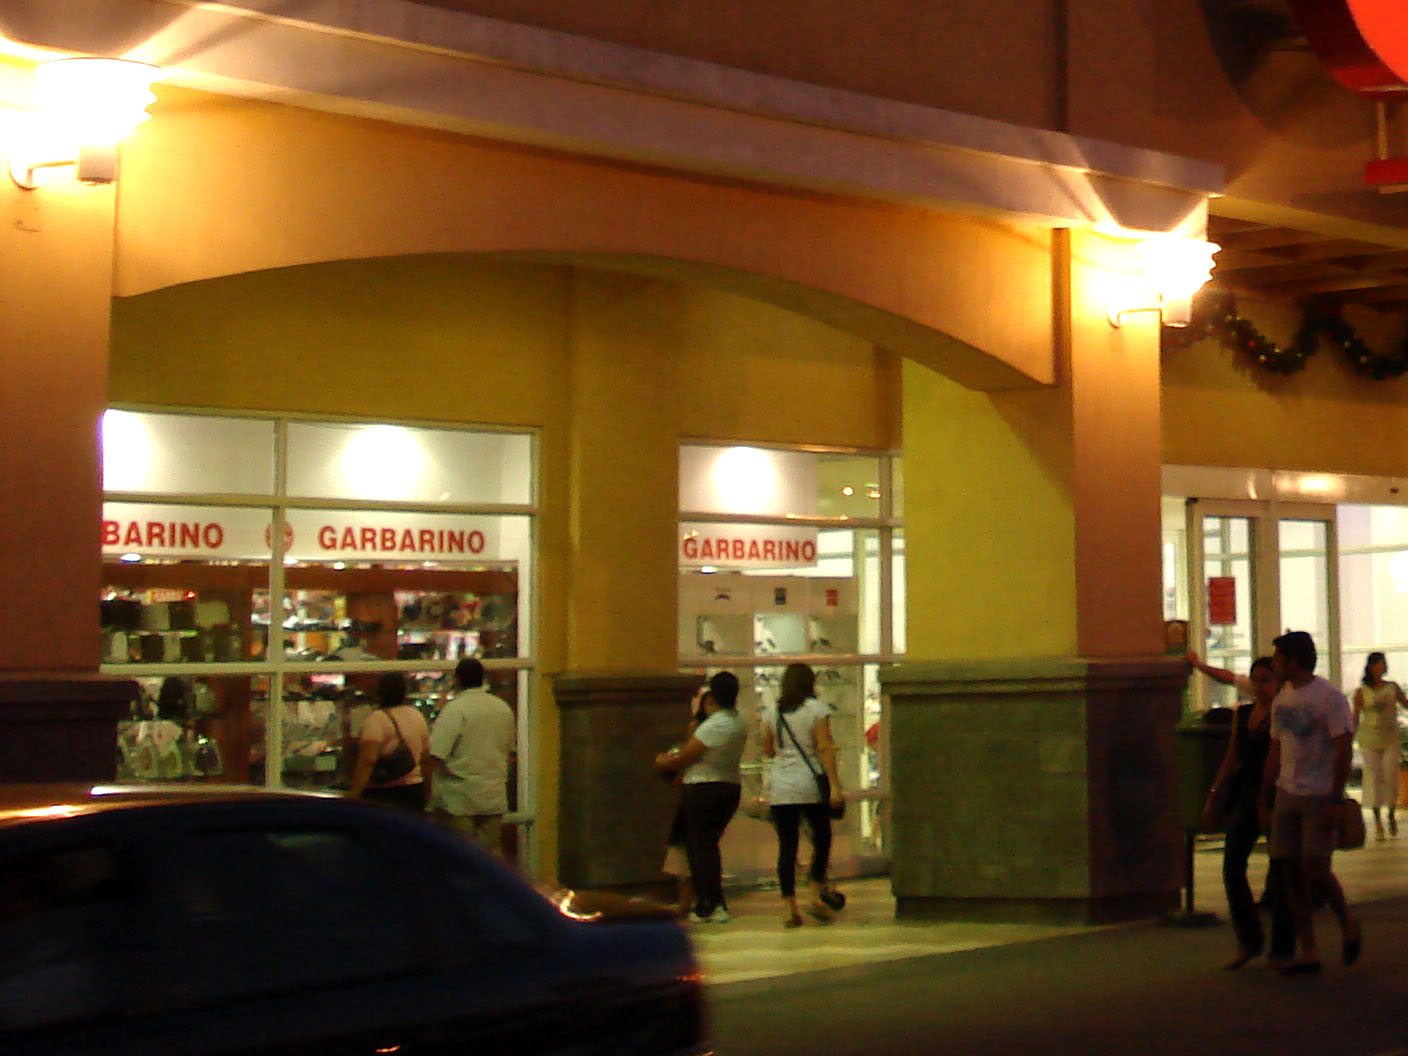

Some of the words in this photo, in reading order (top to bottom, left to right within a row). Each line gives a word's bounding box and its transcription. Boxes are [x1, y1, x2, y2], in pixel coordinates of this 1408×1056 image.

[102, 520, 224, 550] BARINO
[317, 525, 486, 555] GARBARINO
[682, 537, 818, 561] GARBARINO
